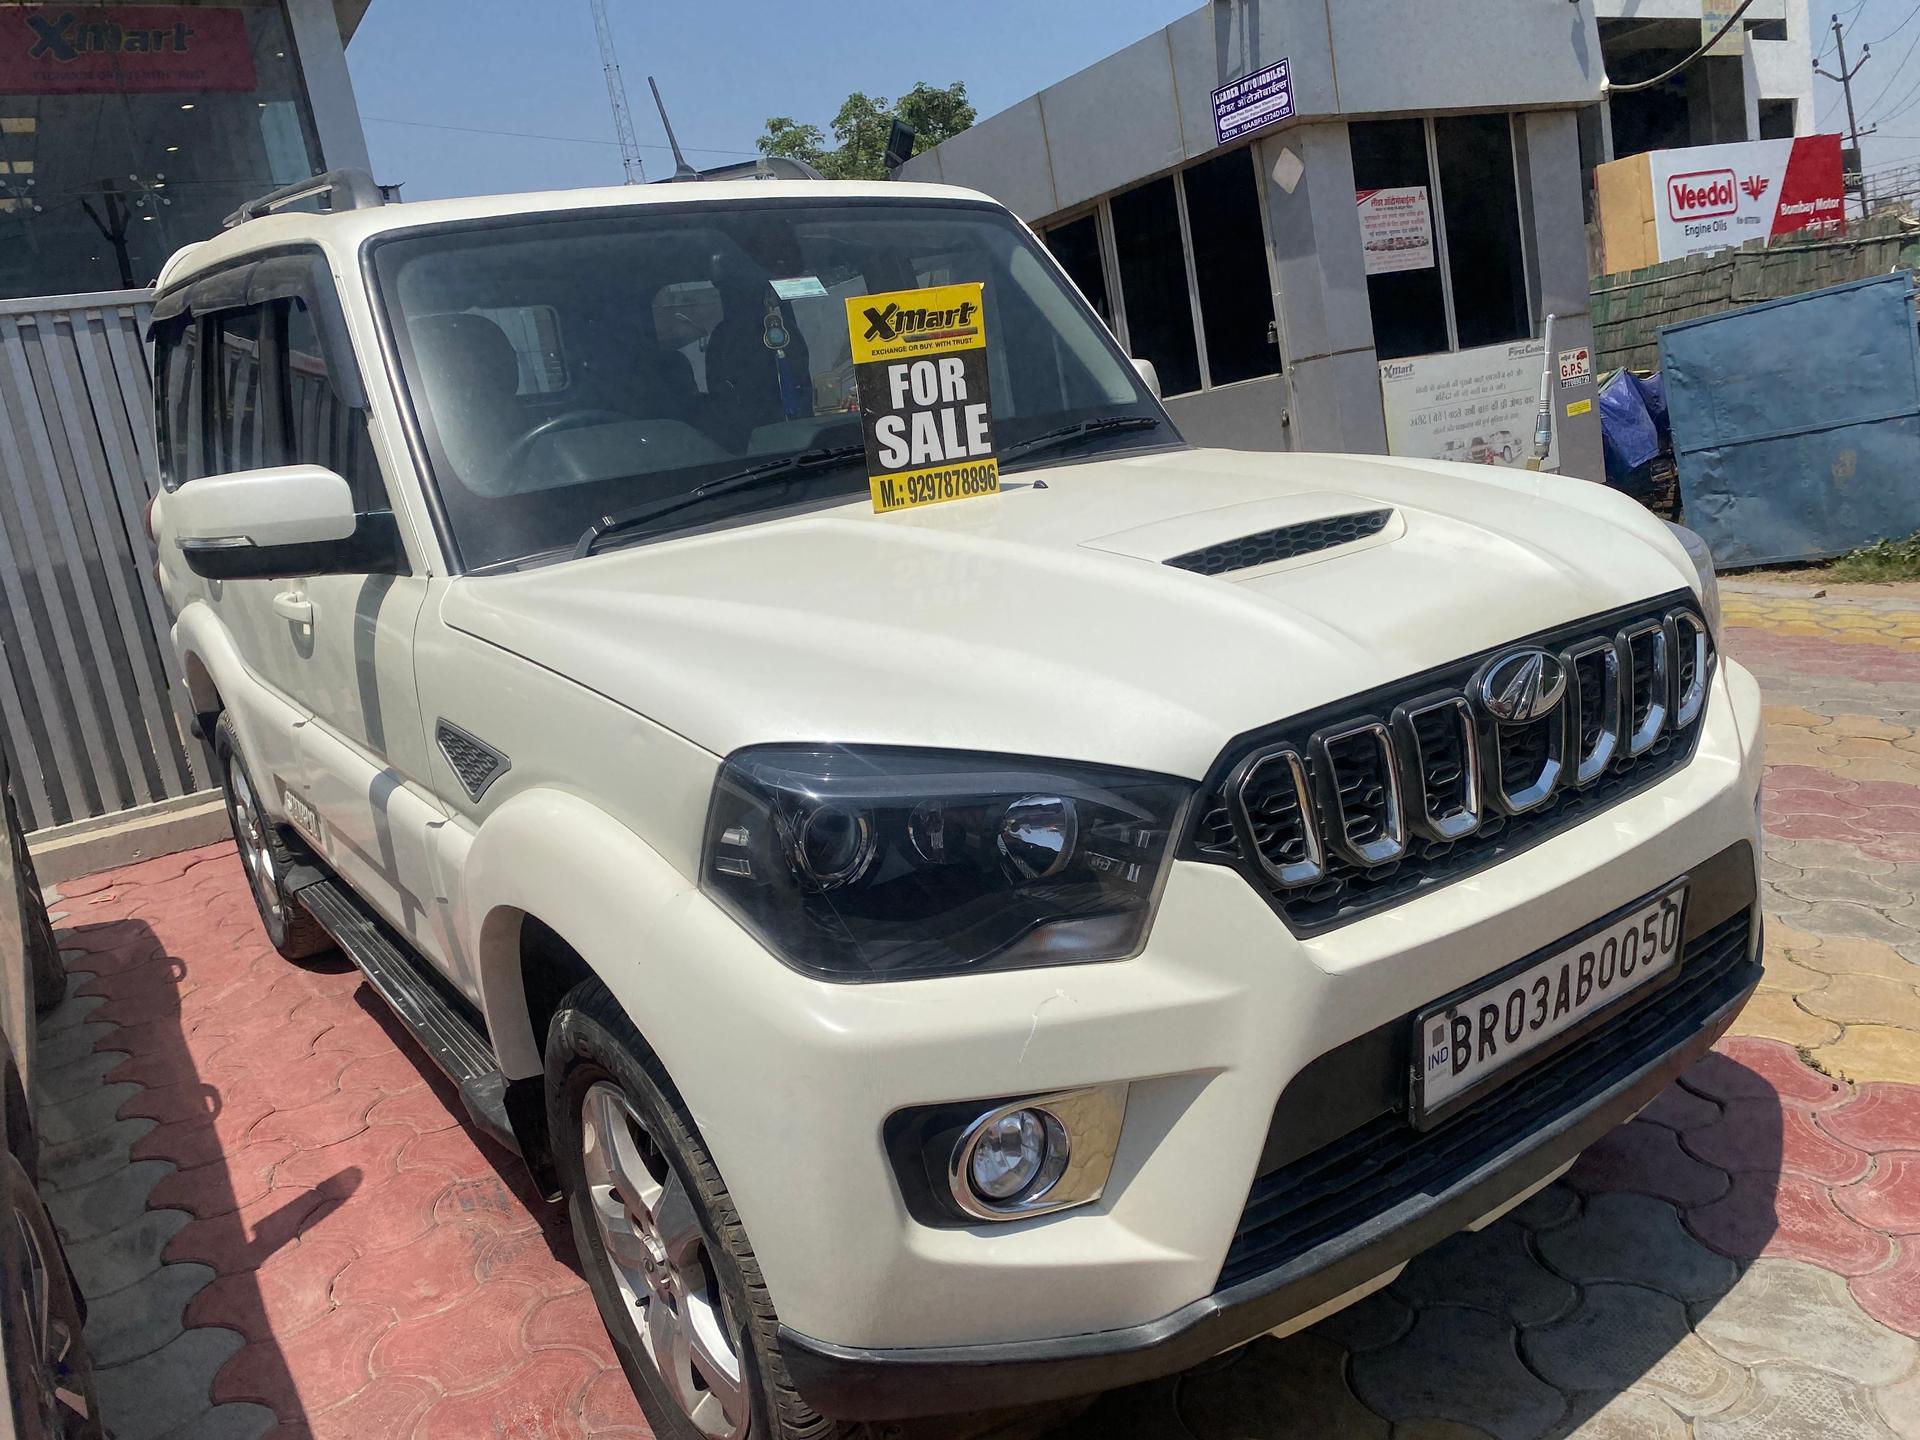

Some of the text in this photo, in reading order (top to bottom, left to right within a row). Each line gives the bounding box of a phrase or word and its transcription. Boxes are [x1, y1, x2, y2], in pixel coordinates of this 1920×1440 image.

[26, 11, 194, 62] Xmart
[1215, 65, 1286, 105] LEADER AUTOMOBILES
[1221, 128, 1238, 139] GSTIN
[1673, 180, 1734, 211] Veedol
[1780, 197, 1840, 216] Bombay Motor
[1685, 223, 1711, 238] Engine
[1712, 220, 1728, 233] Oils
[863, 302, 977, 341] Xmart
[871, 345, 907, 356] EXCHANGE
[908, 344, 919, 353] OR
[935, 340, 951, 348] WITH
[1508, 347, 1524, 357] First
[888, 357, 968, 410] FOR
[1384, 363, 1415, 378] Xmart
[1562, 362, 1583, 378] G.P.S
[875, 403, 992, 469] SALE
[880, 464, 997, 508] M.: 9297878896
[1451, 903, 1680, 1077] BR03AB0050
[1428, 1046, 1449, 1071] IND
